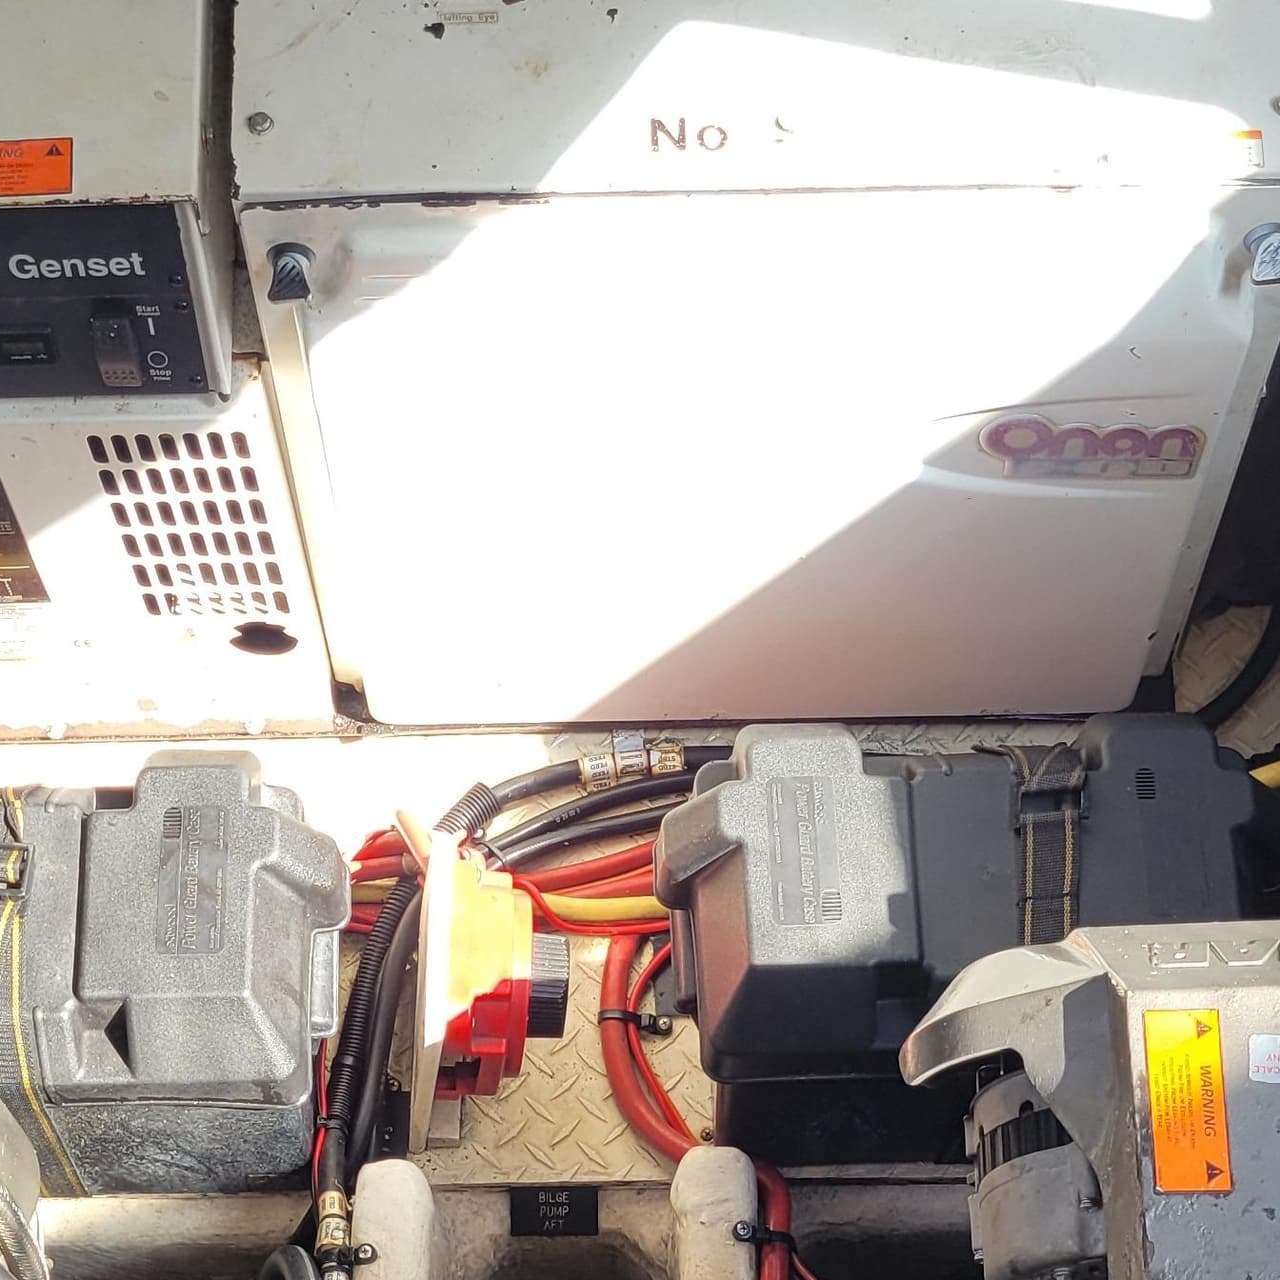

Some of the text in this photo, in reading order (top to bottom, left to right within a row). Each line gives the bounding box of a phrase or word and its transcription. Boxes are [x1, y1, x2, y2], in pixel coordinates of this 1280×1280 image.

[650, 117, 728, 152] No
[8, 252, 146, 280] Genset
[136, 304, 160, 313] Start
[150, 369, 172, 378] Stop
[795, 783, 810, 819] Power
[798, 821, 813, 854] Guard
[800, 856, 816, 894] Battery
[1254, 1064, 1280, 1075] CALL
[1200, 1064, 1217, 1137] WARNING
[538, 1191, 570, 1203] BILGE
[540, 1205, 569, 1217] PUMP
[543, 1220, 565, 1230] AFT
